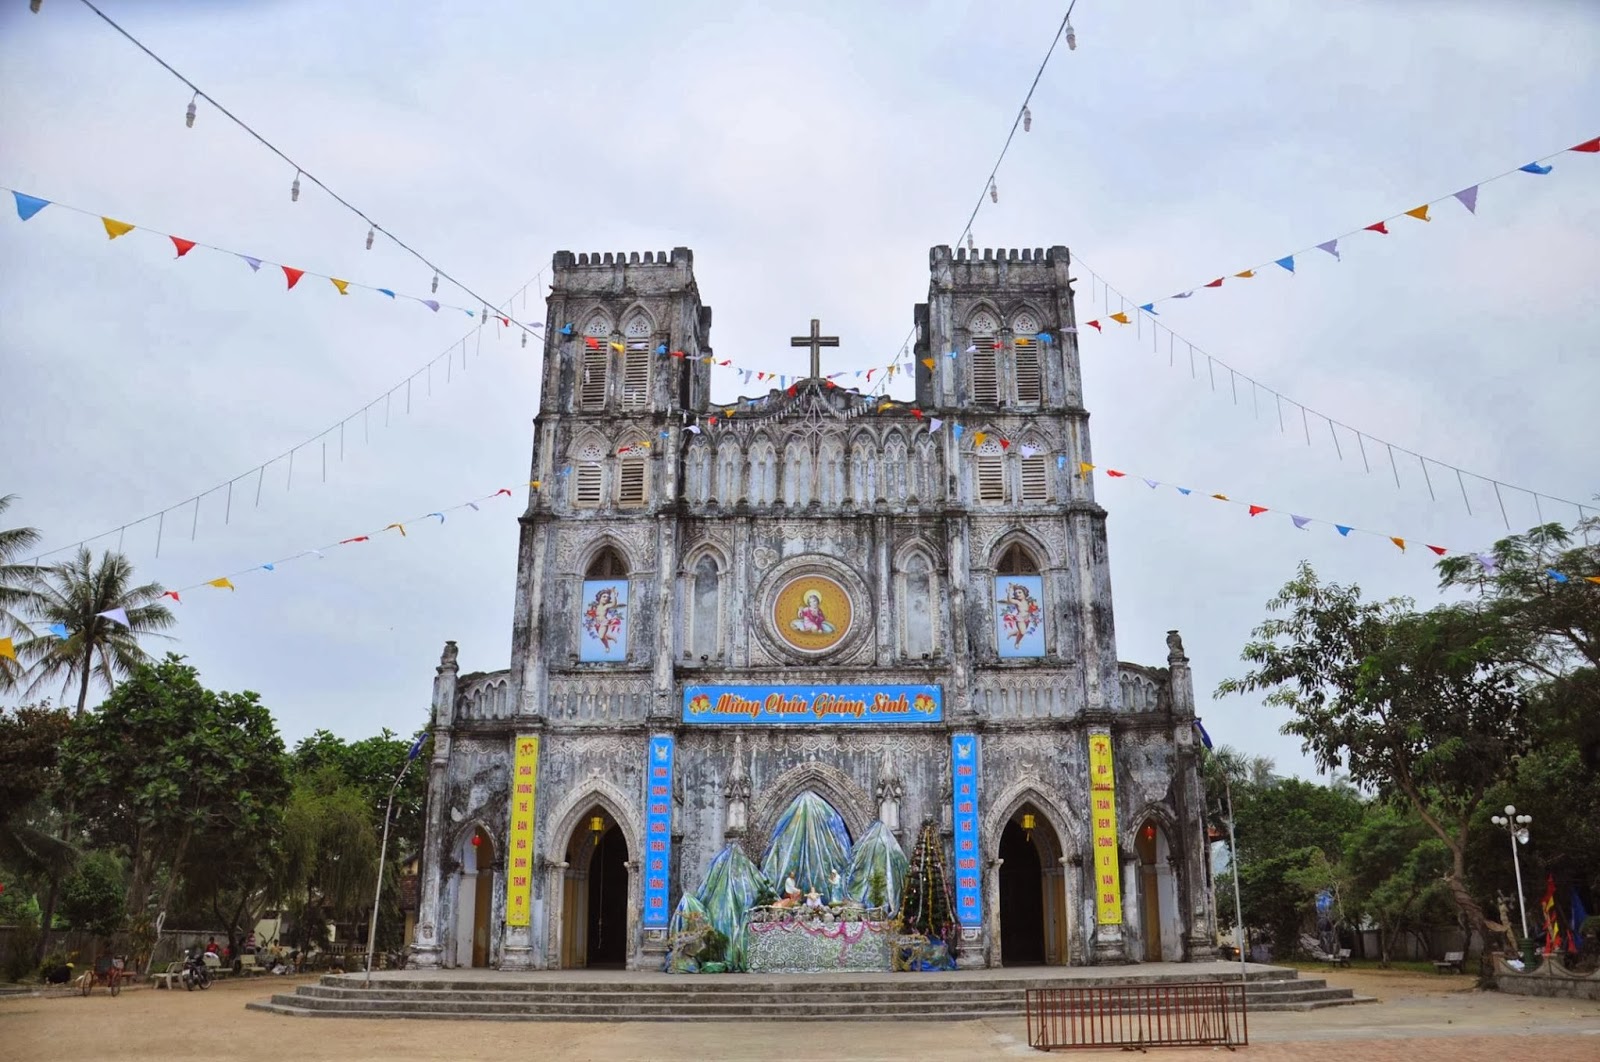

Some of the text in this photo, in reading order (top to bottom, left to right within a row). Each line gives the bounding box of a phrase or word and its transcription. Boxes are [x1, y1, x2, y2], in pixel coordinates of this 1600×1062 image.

[711, 692, 909, 719] Mừng Chúa Giáng Sinh
[654, 766, 668, 777] VINH
[958, 764, 972, 776] BÌNH
[652, 786, 668, 796] DANH
[962, 784, 970, 795] AN
[652, 802, 668, 814] THIÊN
[962, 818, 971, 832] THẾ
[650, 840, 665, 852] TRÊN
[962, 840, 972, 850] CHO
[960, 876, 977, 890] THIỆN
[962, 896, 975, 907] TÂM
